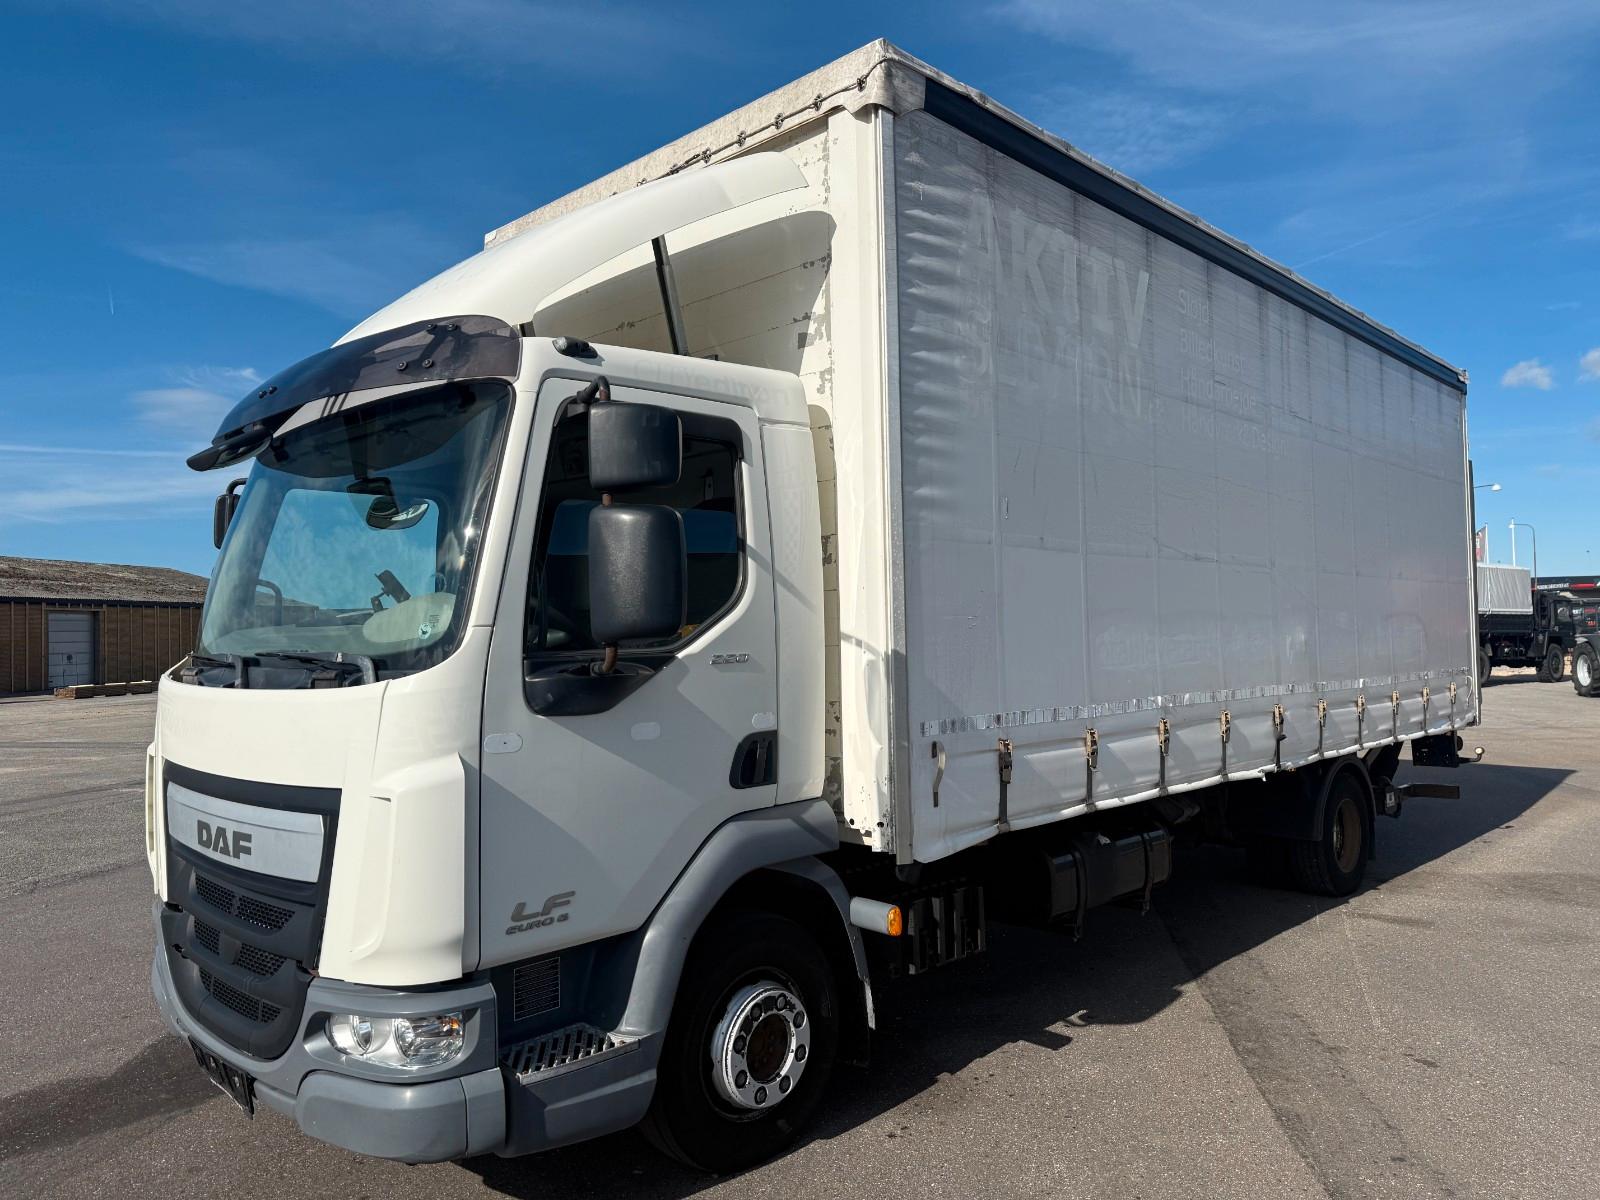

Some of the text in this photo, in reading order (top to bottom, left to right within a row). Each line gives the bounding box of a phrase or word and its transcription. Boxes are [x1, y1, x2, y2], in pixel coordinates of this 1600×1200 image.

[710, 652, 750, 665] 220
[197, 819, 252, 860] DAF
[511, 890, 576, 923] LF
[505, 912, 570, 936] EURO 6
